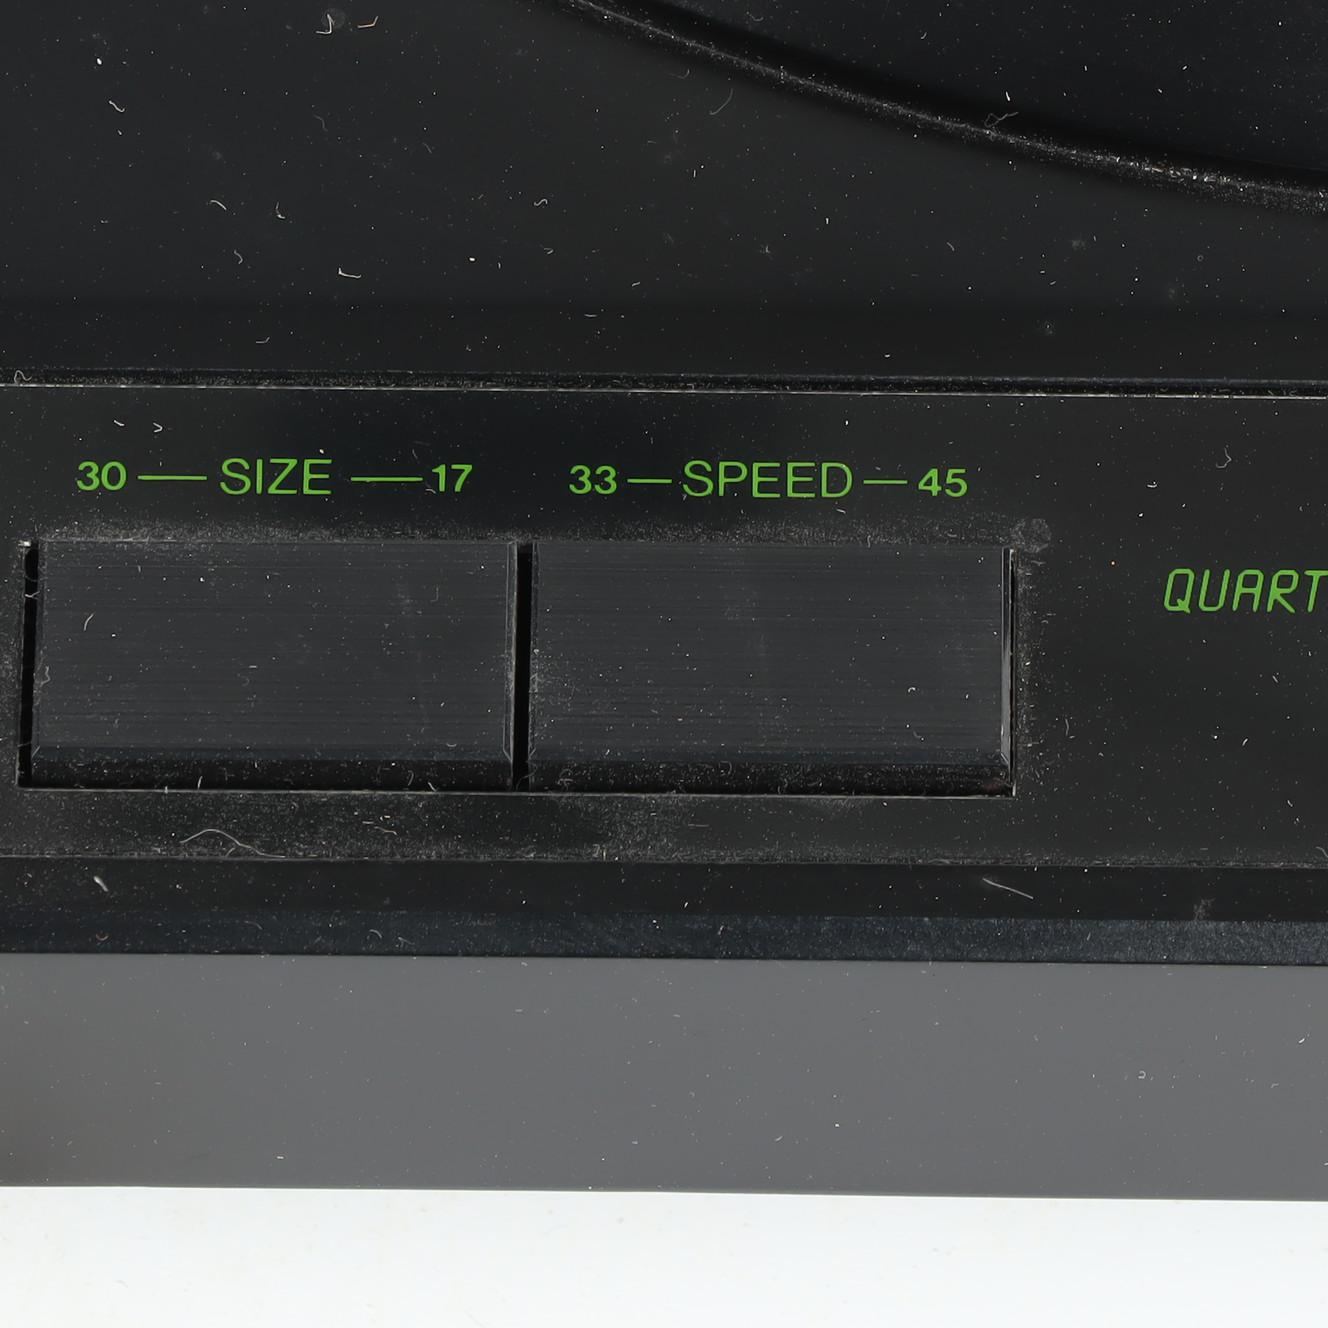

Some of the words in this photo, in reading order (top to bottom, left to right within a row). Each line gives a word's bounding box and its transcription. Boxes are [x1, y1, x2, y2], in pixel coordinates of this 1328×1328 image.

[77, 461, 126, 490] 30
[220, 458, 332, 494] SIZE
[433, 464, 472, 492] 17
[570, 465, 617, 494] 33
[683, 460, 852, 497] SPEED
[918, 468, 967, 496] 45
